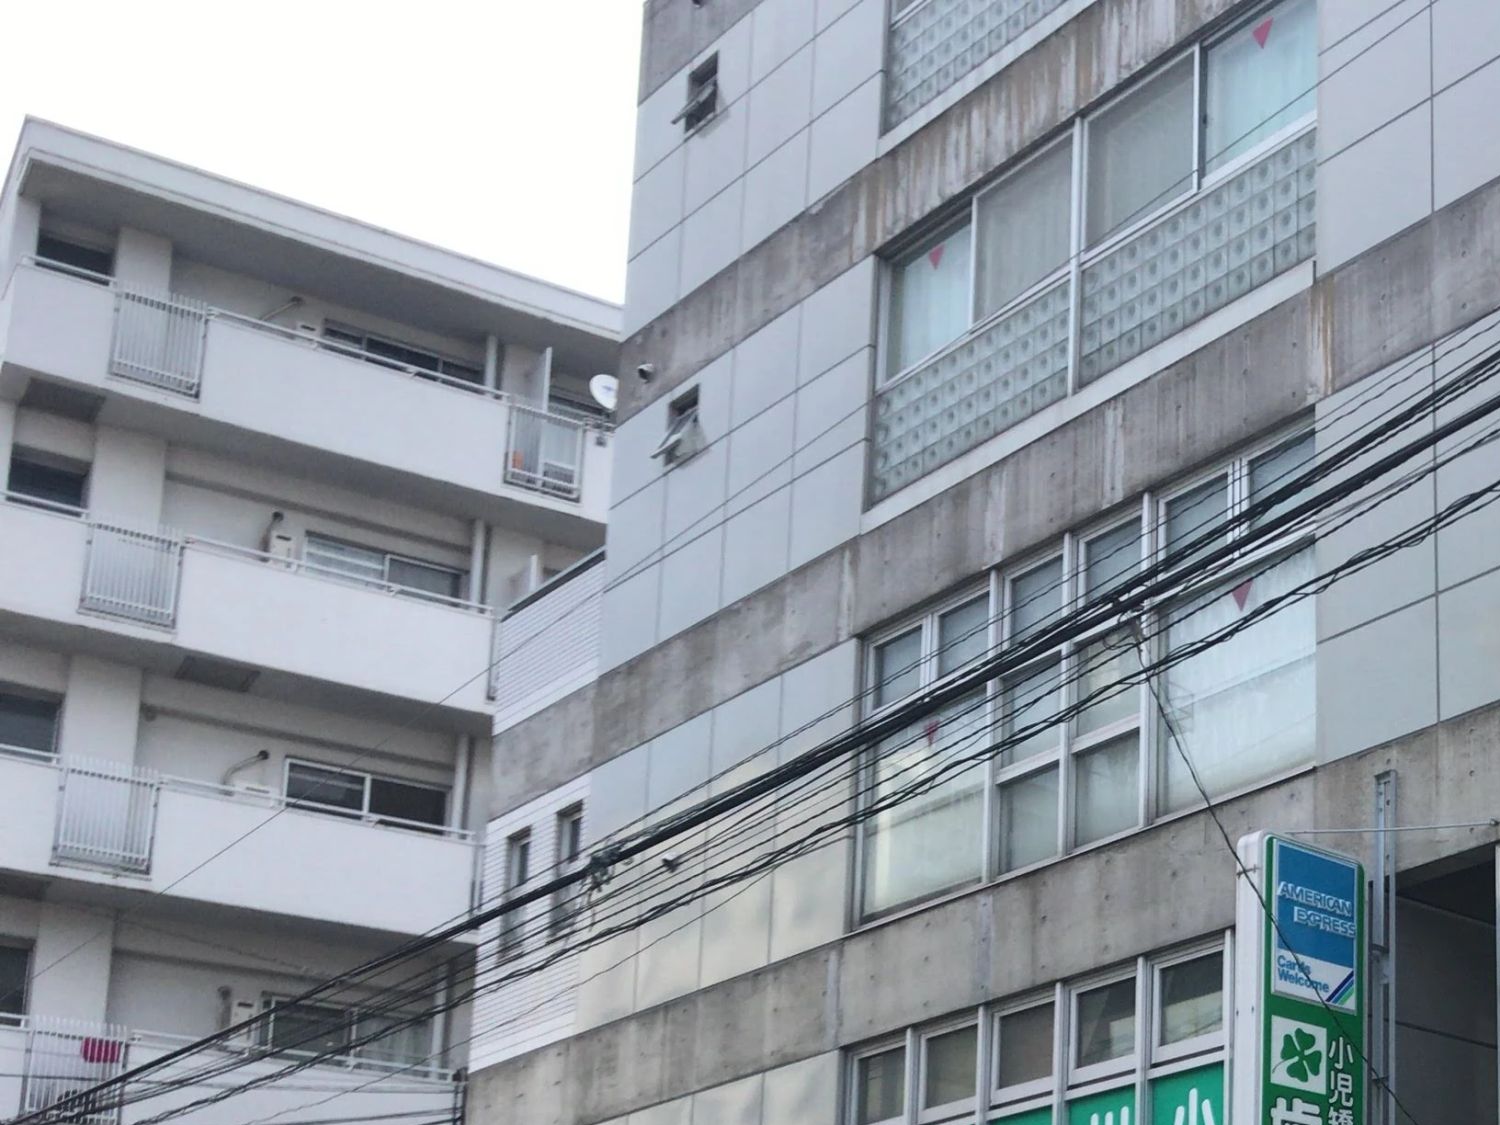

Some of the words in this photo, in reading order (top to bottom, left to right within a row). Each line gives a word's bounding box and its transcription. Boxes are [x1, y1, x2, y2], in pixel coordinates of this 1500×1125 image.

[1277, 881, 1351, 916] AMERICAN
[1294, 906, 1356, 938] EXPRESS
[1277, 955, 1312, 977] Cards
[1277, 968, 1330, 993] Welcome
